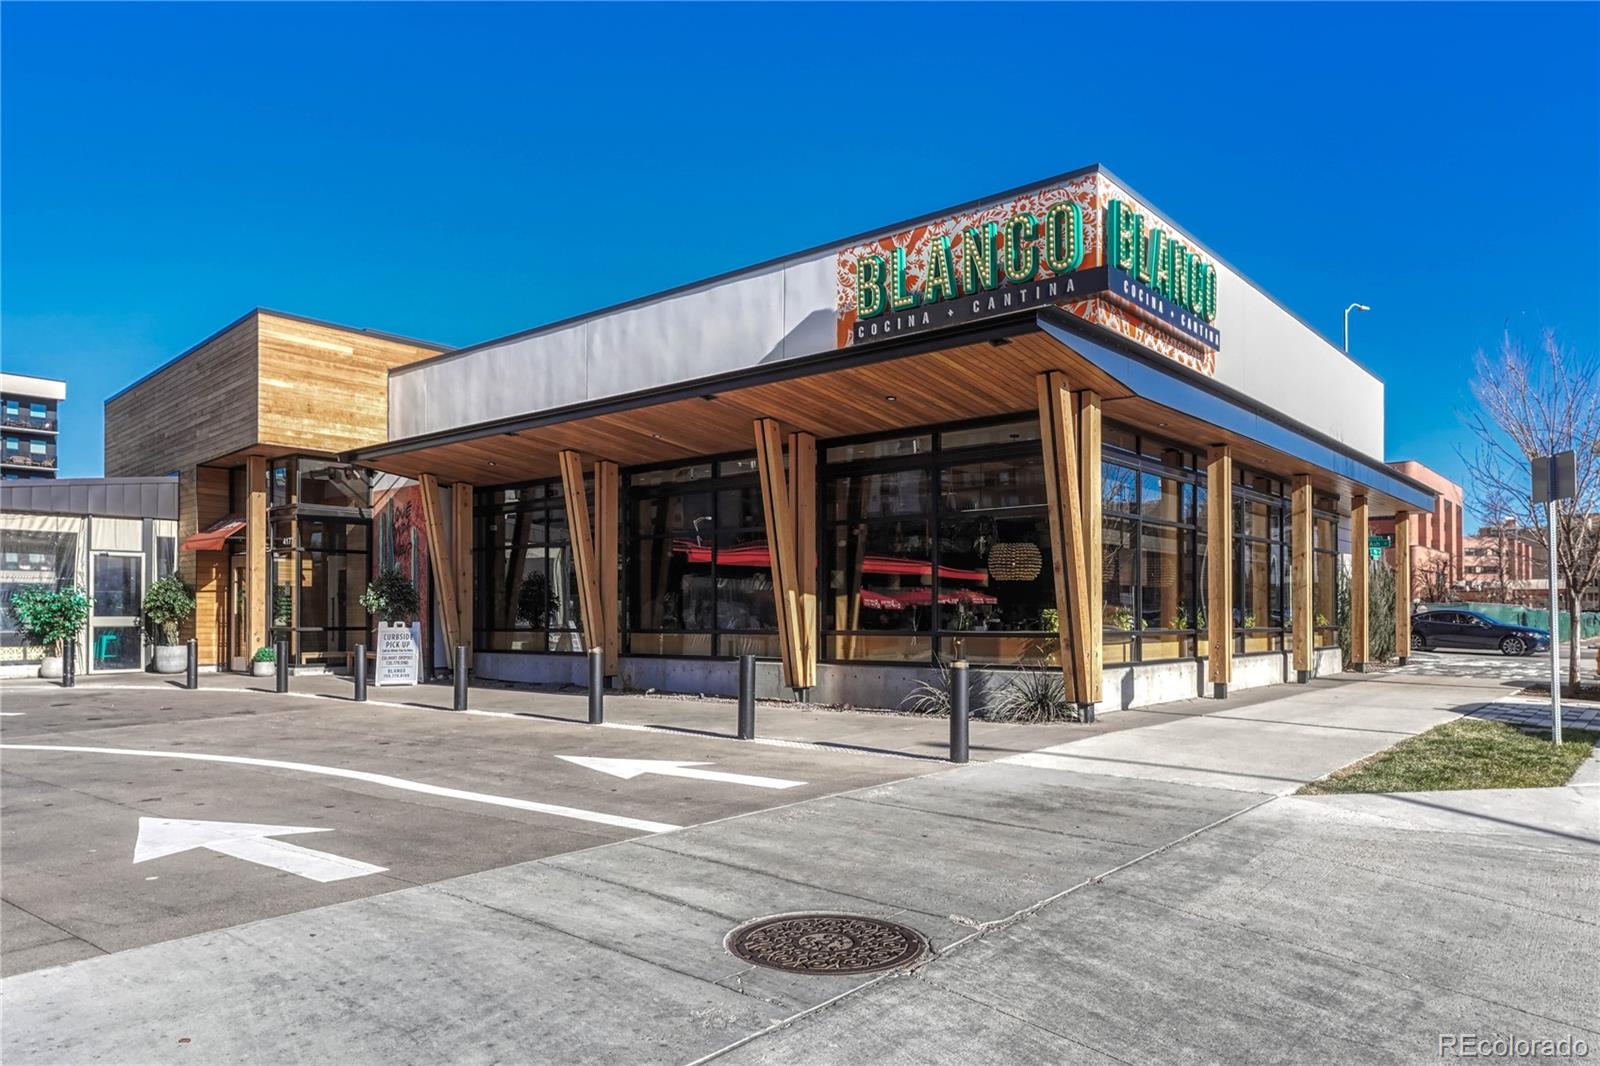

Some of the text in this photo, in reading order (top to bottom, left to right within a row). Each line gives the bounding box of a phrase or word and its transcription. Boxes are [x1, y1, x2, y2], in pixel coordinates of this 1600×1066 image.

[857, 200, 1083, 319] BLANCO
[1108, 198, 1217, 323] BLANCO
[857, 278, 1075, 338] COCINA CANTINA
[1123, 279, 1220, 346] COCINA CANTINA
[383, 633, 414, 641] CURBSIDE
